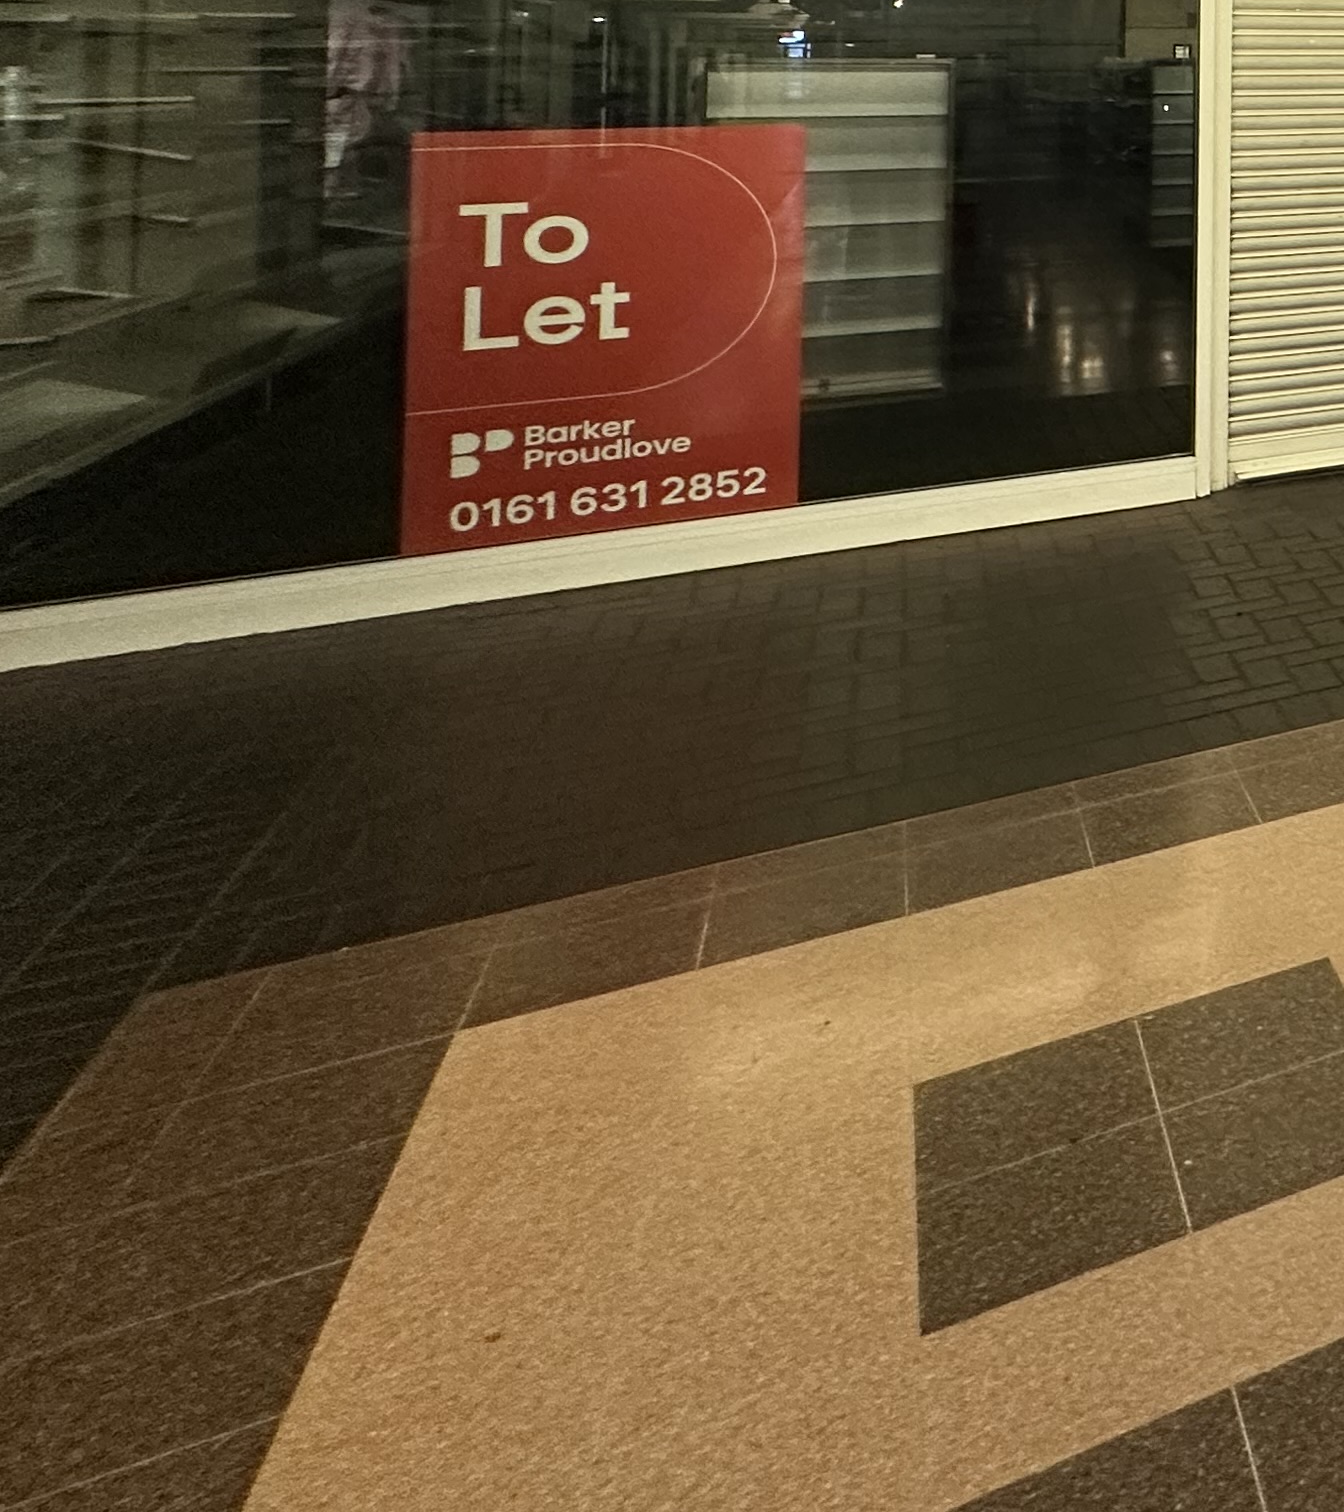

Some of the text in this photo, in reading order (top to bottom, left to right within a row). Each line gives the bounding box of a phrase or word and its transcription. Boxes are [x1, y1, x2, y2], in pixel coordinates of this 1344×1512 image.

[458, 201, 589, 268] To
[463, 281, 630, 352] Let
[523, 436, 692, 470] Proudlove
[524, 418, 636, 447] Barker
[450, 466, 768, 532] 0161 631 2852
